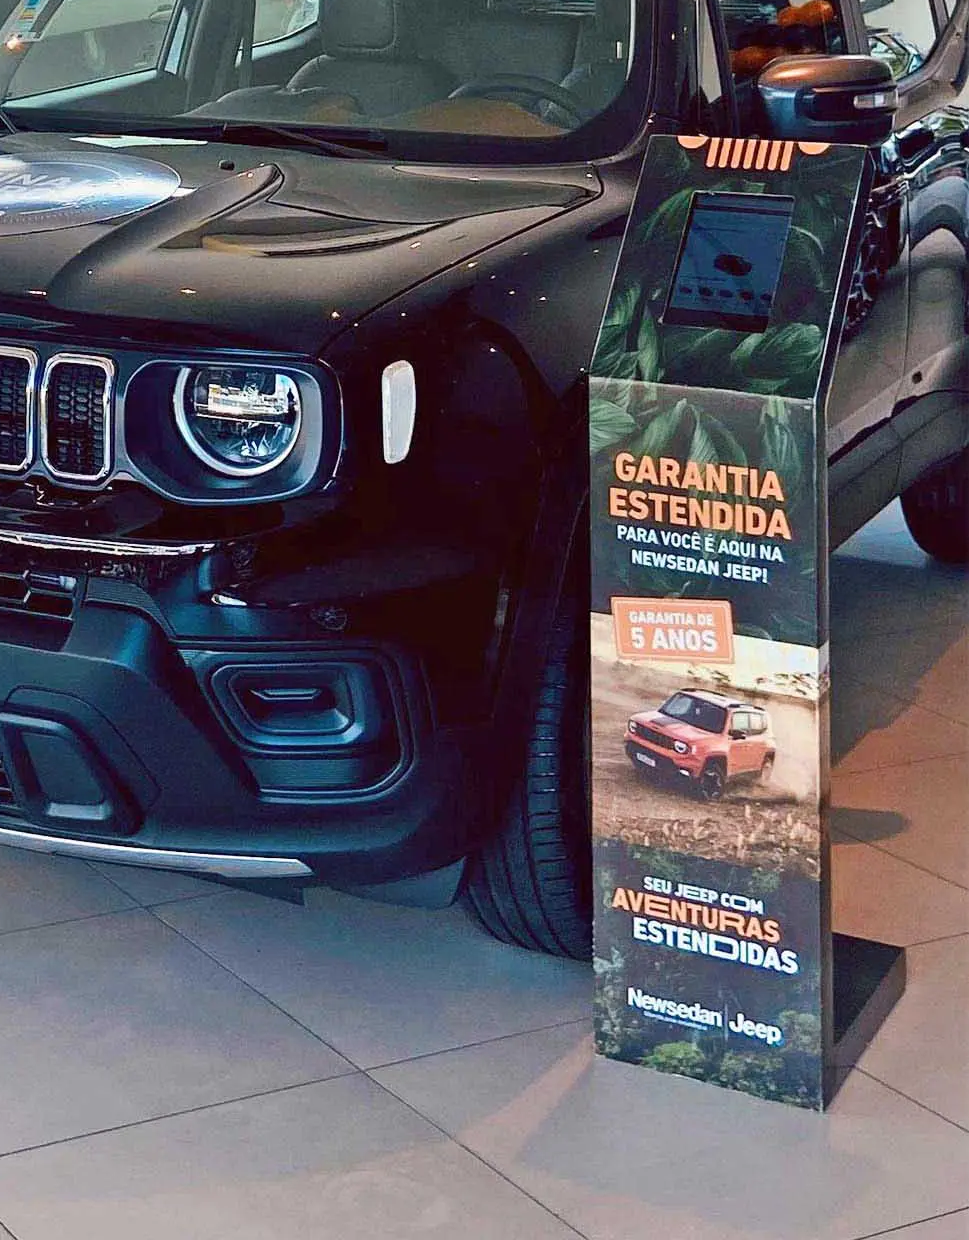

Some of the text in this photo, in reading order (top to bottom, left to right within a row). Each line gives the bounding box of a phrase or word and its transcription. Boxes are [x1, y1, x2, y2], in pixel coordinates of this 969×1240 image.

[615, 452, 785, 502] GARANTIA
[609, 487, 792, 540] ESTENDIDA
[617, 525, 783, 563] PARA VOCÊ É AQUI NA
[632, 550, 768, 584] NEWSEDAN JEEP!
[629, 612, 715, 626] GARANTIA DE
[631, 628, 717, 653] 5 ANOS
[612, 887, 781, 943] AVENTURAS
[643, 876, 764, 914] SEU JEEP COM
[633, 917, 799, 974] ESTENDIDAS
[627, 986, 723, 1027] Newsedan
[729, 1013, 782, 1045] Jeep
